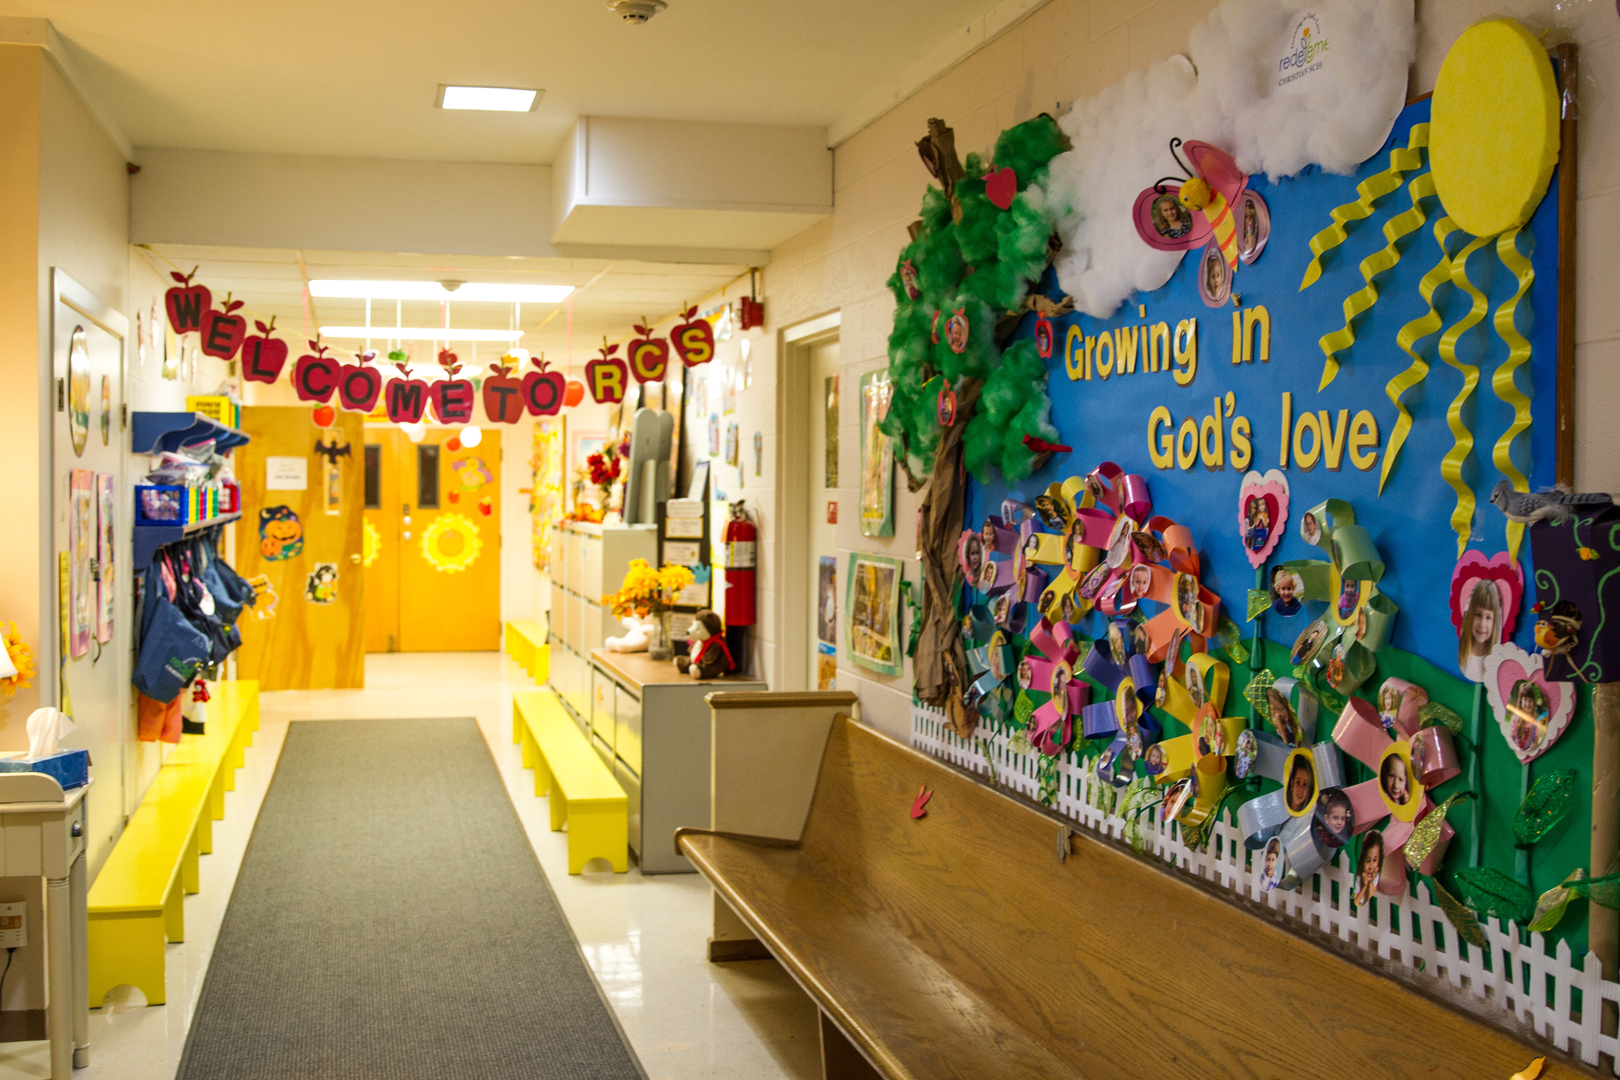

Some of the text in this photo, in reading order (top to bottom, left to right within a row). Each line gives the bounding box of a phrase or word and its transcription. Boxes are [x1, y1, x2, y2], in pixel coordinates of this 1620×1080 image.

[1278, 67, 1308, 87] CHRISTIAN
[172, 292, 712, 420] WELCOME TO RCS
[1065, 291, 1271, 387] Growing in
[1147, 390, 1379, 473] God's love
